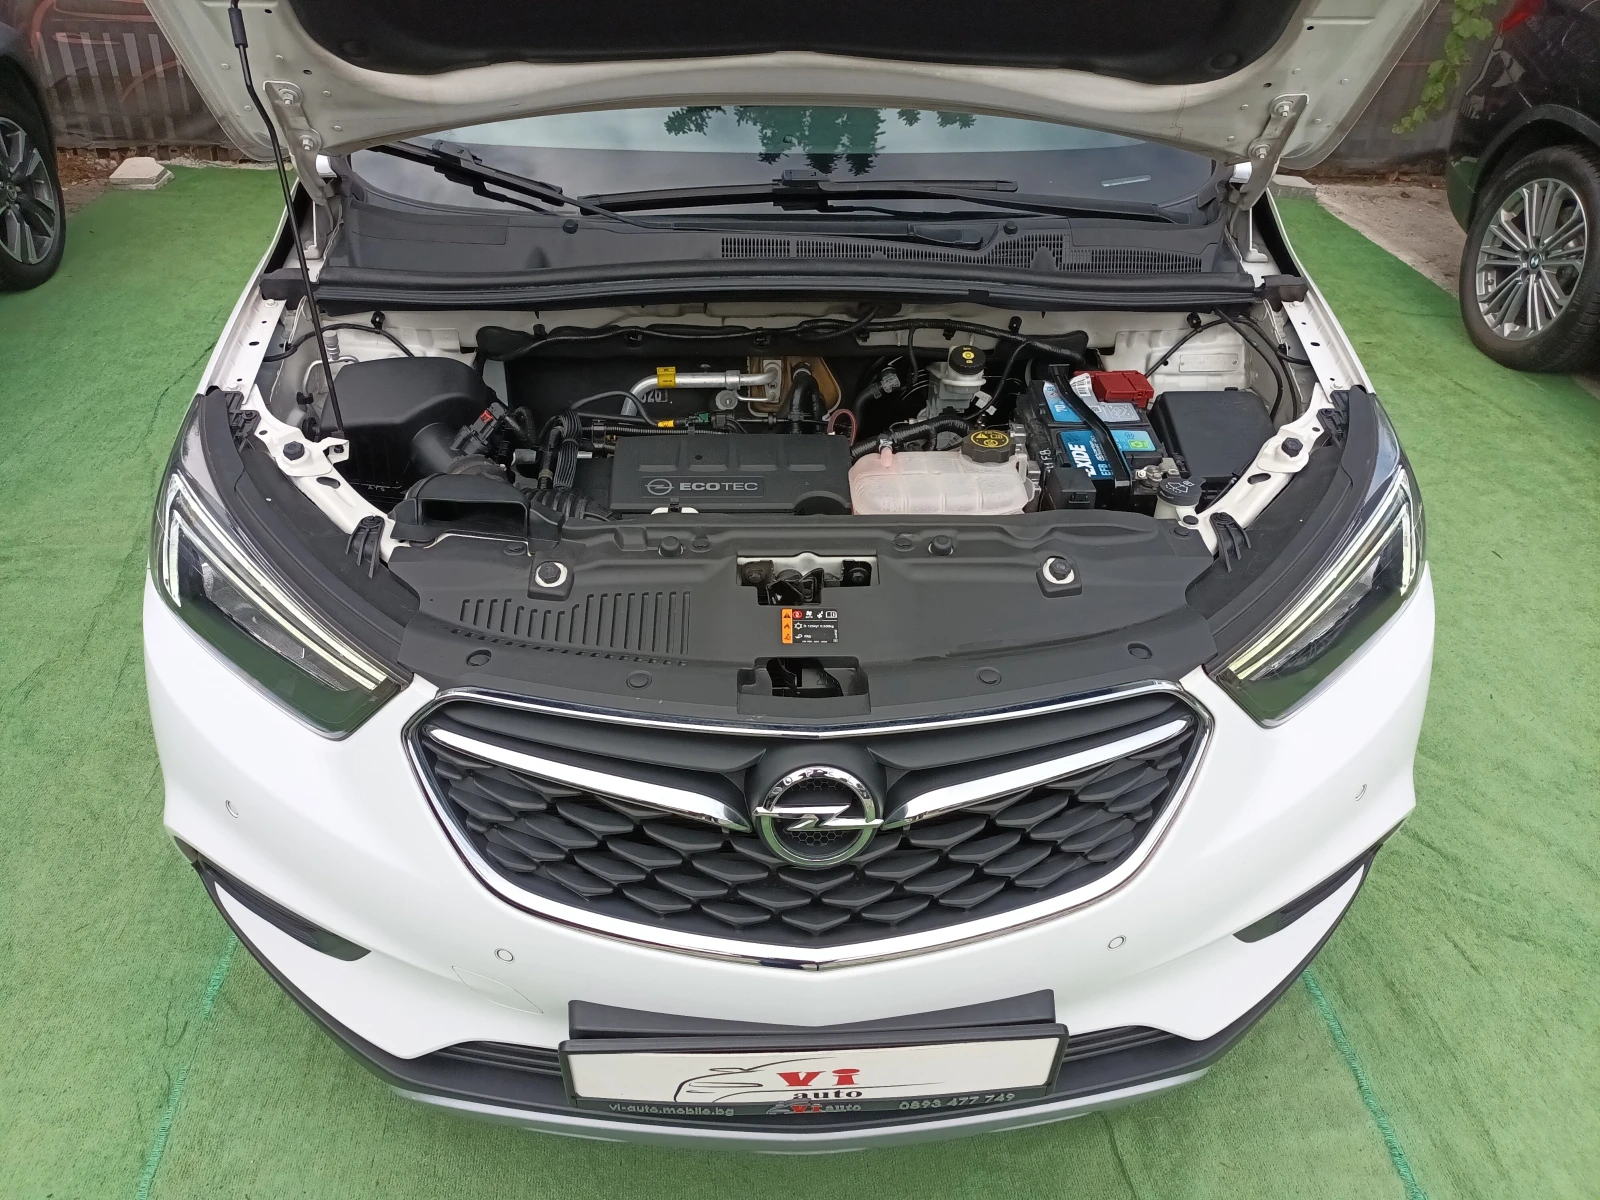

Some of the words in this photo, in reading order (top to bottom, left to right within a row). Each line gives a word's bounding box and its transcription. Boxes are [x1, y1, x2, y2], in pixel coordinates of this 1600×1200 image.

[1097, 463, 1112, 476] EFB
[679, 482, 758, 491] ECOTEC
[793, 1089, 863, 1099] auto
[899, 1099, 940, 1111] 0893
[946, 1096, 980, 1107] 477
[984, 1092, 1016, 1103] 749
[608, 1103, 735, 1117] vi-auto.mobile.bg
